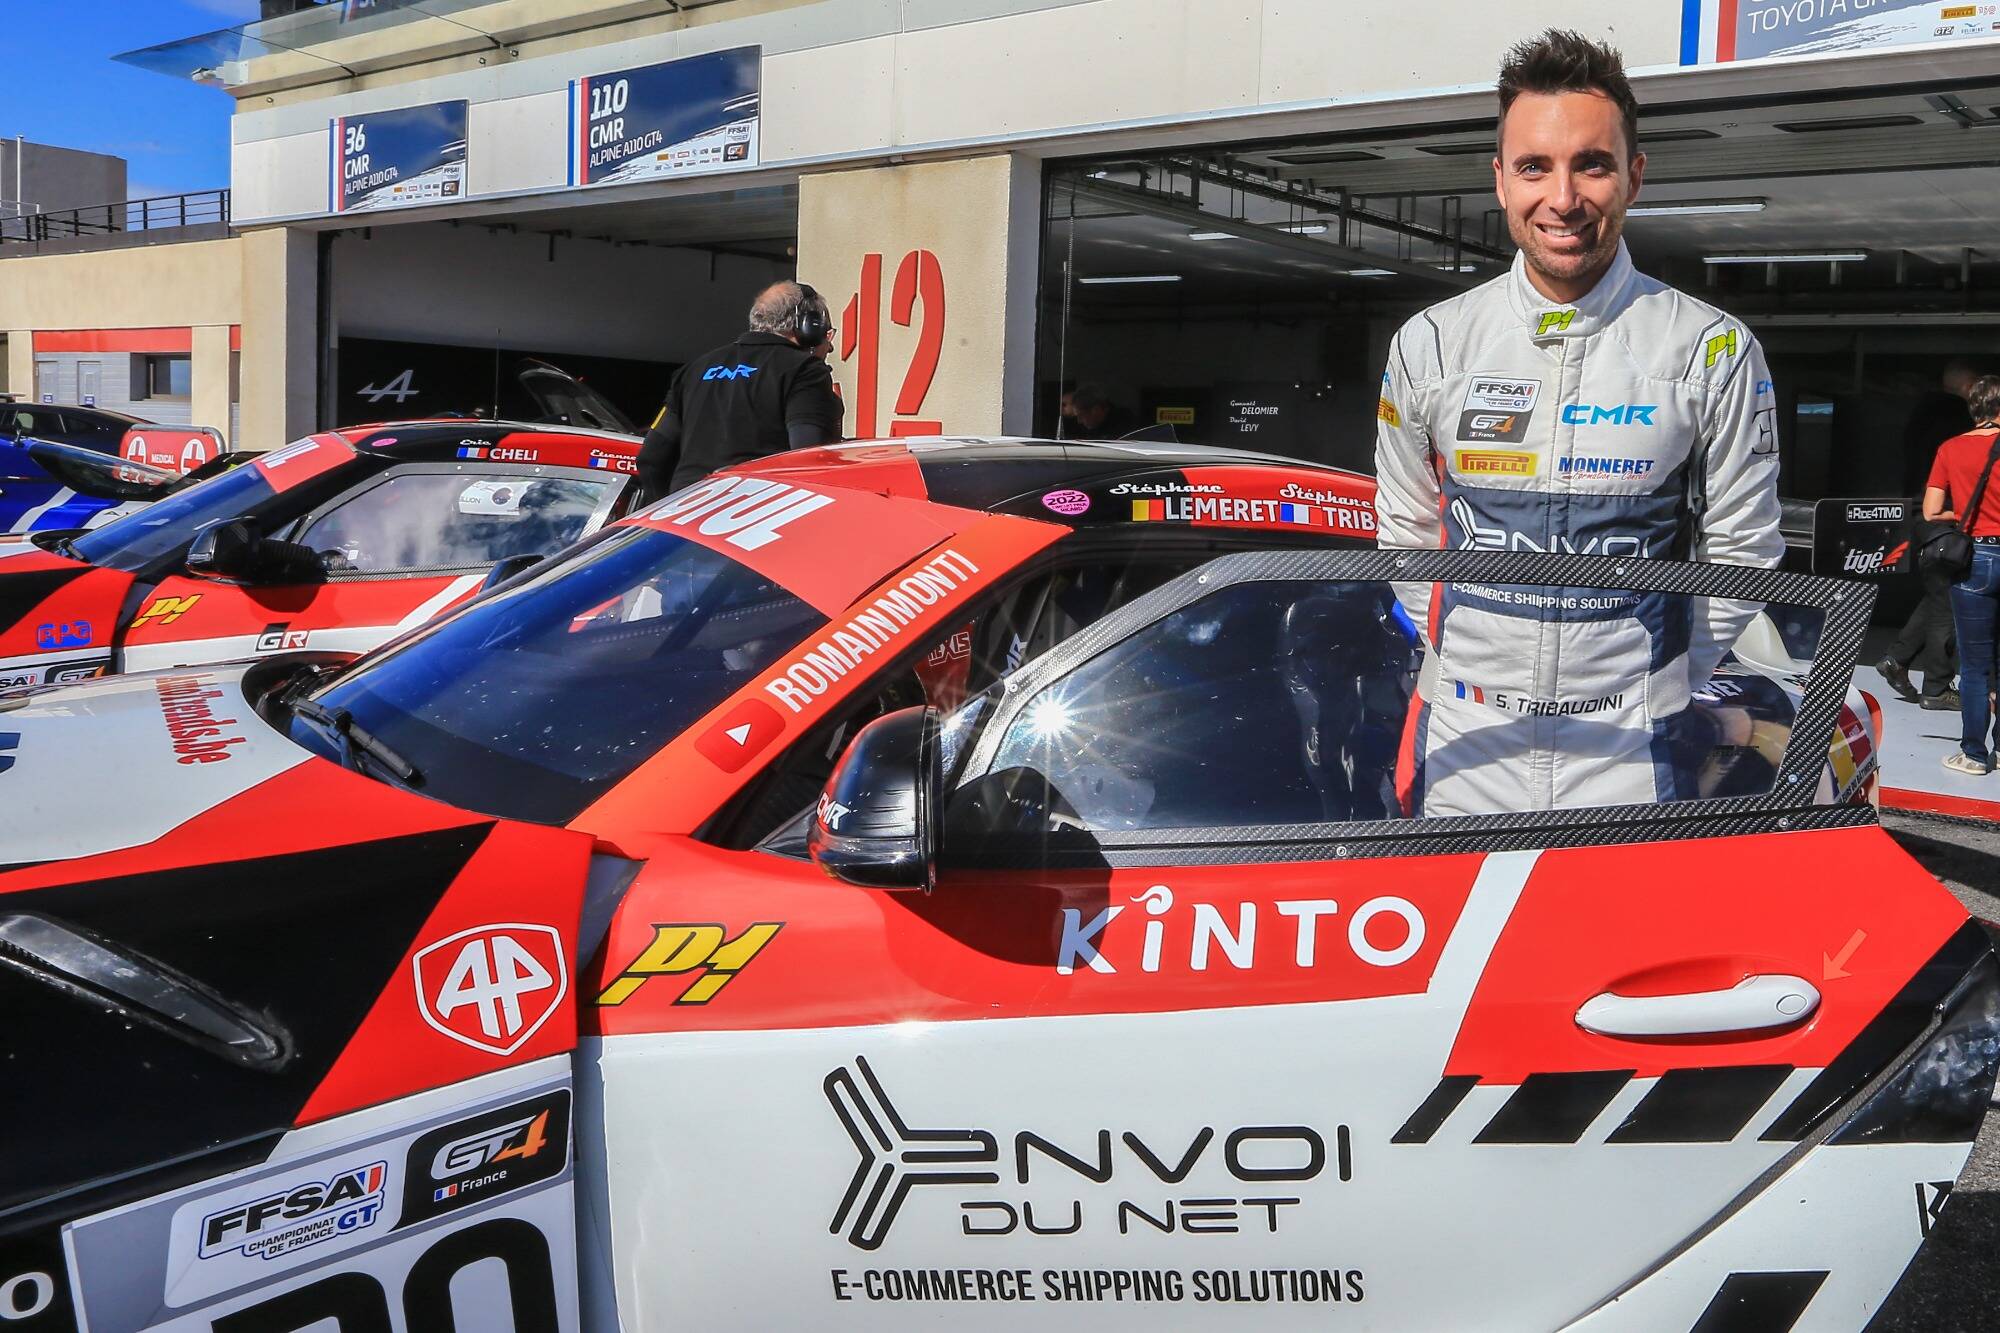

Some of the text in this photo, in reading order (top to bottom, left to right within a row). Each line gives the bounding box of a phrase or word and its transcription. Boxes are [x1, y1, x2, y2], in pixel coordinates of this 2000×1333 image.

[1748, 0, 1847, 34] TOYOTA
[590, 79, 629, 121] 110
[344, 123, 366, 156] 36
[589, 117, 625, 149] CMR
[589, 129, 664, 169] ALPINE A110 GT4
[344, 153, 370, 179] CMR
[344, 166, 399, 196] ALPINE A110 GT4
[1535, 309, 1577, 336] P1
[841, 249, 946, 438] 12
[1705, 328, 1737, 369] P1
[1475, 383, 1526, 397] FFSA
[1513, 400, 1528, 408] GT
[1241, 406, 1279, 415] DELOMIER
[1470, 414, 1517, 433] GT4
[1561, 403, 1659, 426] CMR
[1240, 423, 1260, 432] LEVY
[150, 453, 175, 465] MEDICAL
[489, 448, 538, 462] CHELI
[1461, 453, 1530, 473] PIRELLI
[1557, 456, 1655, 476] MONNERET
[632, 475, 837, 552] OTUL
[1046, 494, 1087, 506] 2022
[1165, 496, 1380, 532] LEMERET TRIB
[1452, 582, 1512, 604] E-COMMERCE
[1579, 592, 1642, 609] SOLUTIONS
[258, 629, 309, 651] GR
[763, 549, 980, 714] ROMAINMONTI
[1495, 694, 1624, 718] S. TRIBAUDINI
[816, 792, 851, 831] CMR
[430, 1108, 549, 1180] GT4
[461, 1169, 508, 1193] France
[206, 1174, 367, 1247] FFSA
[960, 1196, 1302, 1236] DU NET
[248, 1202, 379, 1253] CHAMPIONNAT GT
[268, 1226, 335, 1256] DE FRANCE
[831, 1268, 1368, 1304] E-COMMERCE SHIPPING SOLUTIONS
